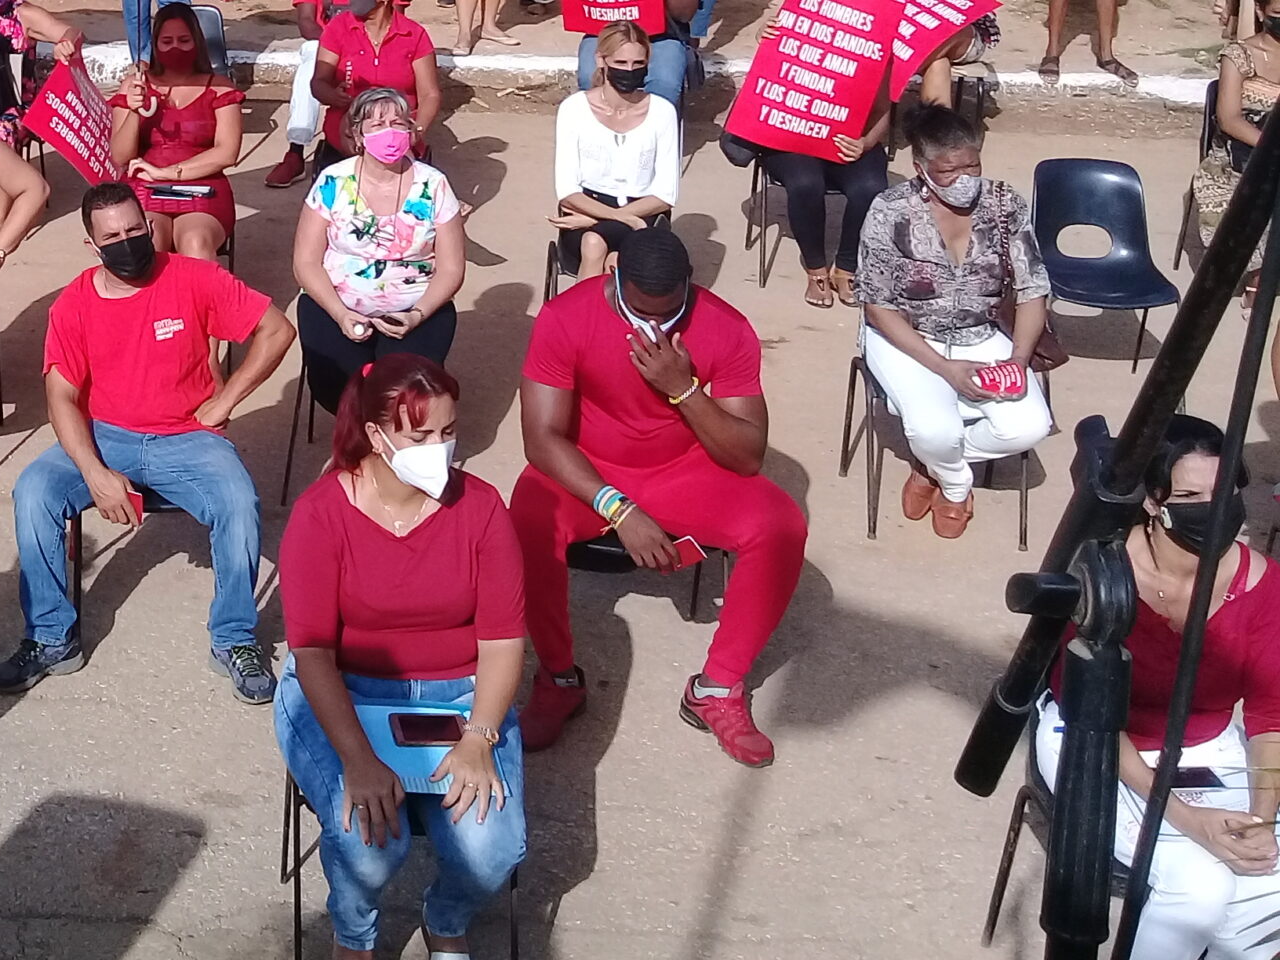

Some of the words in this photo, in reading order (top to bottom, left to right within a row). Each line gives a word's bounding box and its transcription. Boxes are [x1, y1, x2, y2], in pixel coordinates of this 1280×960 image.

[590, 5, 640, 21] DESHACEN
[819, 0, 875, 32] HOMBRES
[794, 13, 812, 34] EN
[809, 19, 834, 43] DOS
[832, 27, 884, 61] BANDOS:
[778, 35, 800, 56] LOS
[799, 44, 824, 65] QUE
[822, 53, 858, 77] AMAN
[779, 61, 791, 78] Y
[787, 66, 836, 98] FUNDAN,
[45, 90, 81, 130] BANDOS:
[65, 90, 88, 118] AMAN
[755, 77, 767, 94] Y
[762, 81, 785, 103] LOS
[785, 89, 811, 112] QUE
[810, 99, 849, 122] ODIAN
[49, 116, 90, 160] HOMBRES
[80, 126, 95, 148] DOS
[759, 104, 770, 121] Y
[768, 109, 831, 140] DESHACEN
[89, 156, 104, 178] LOS
[95, 146, 105, 161] EN
